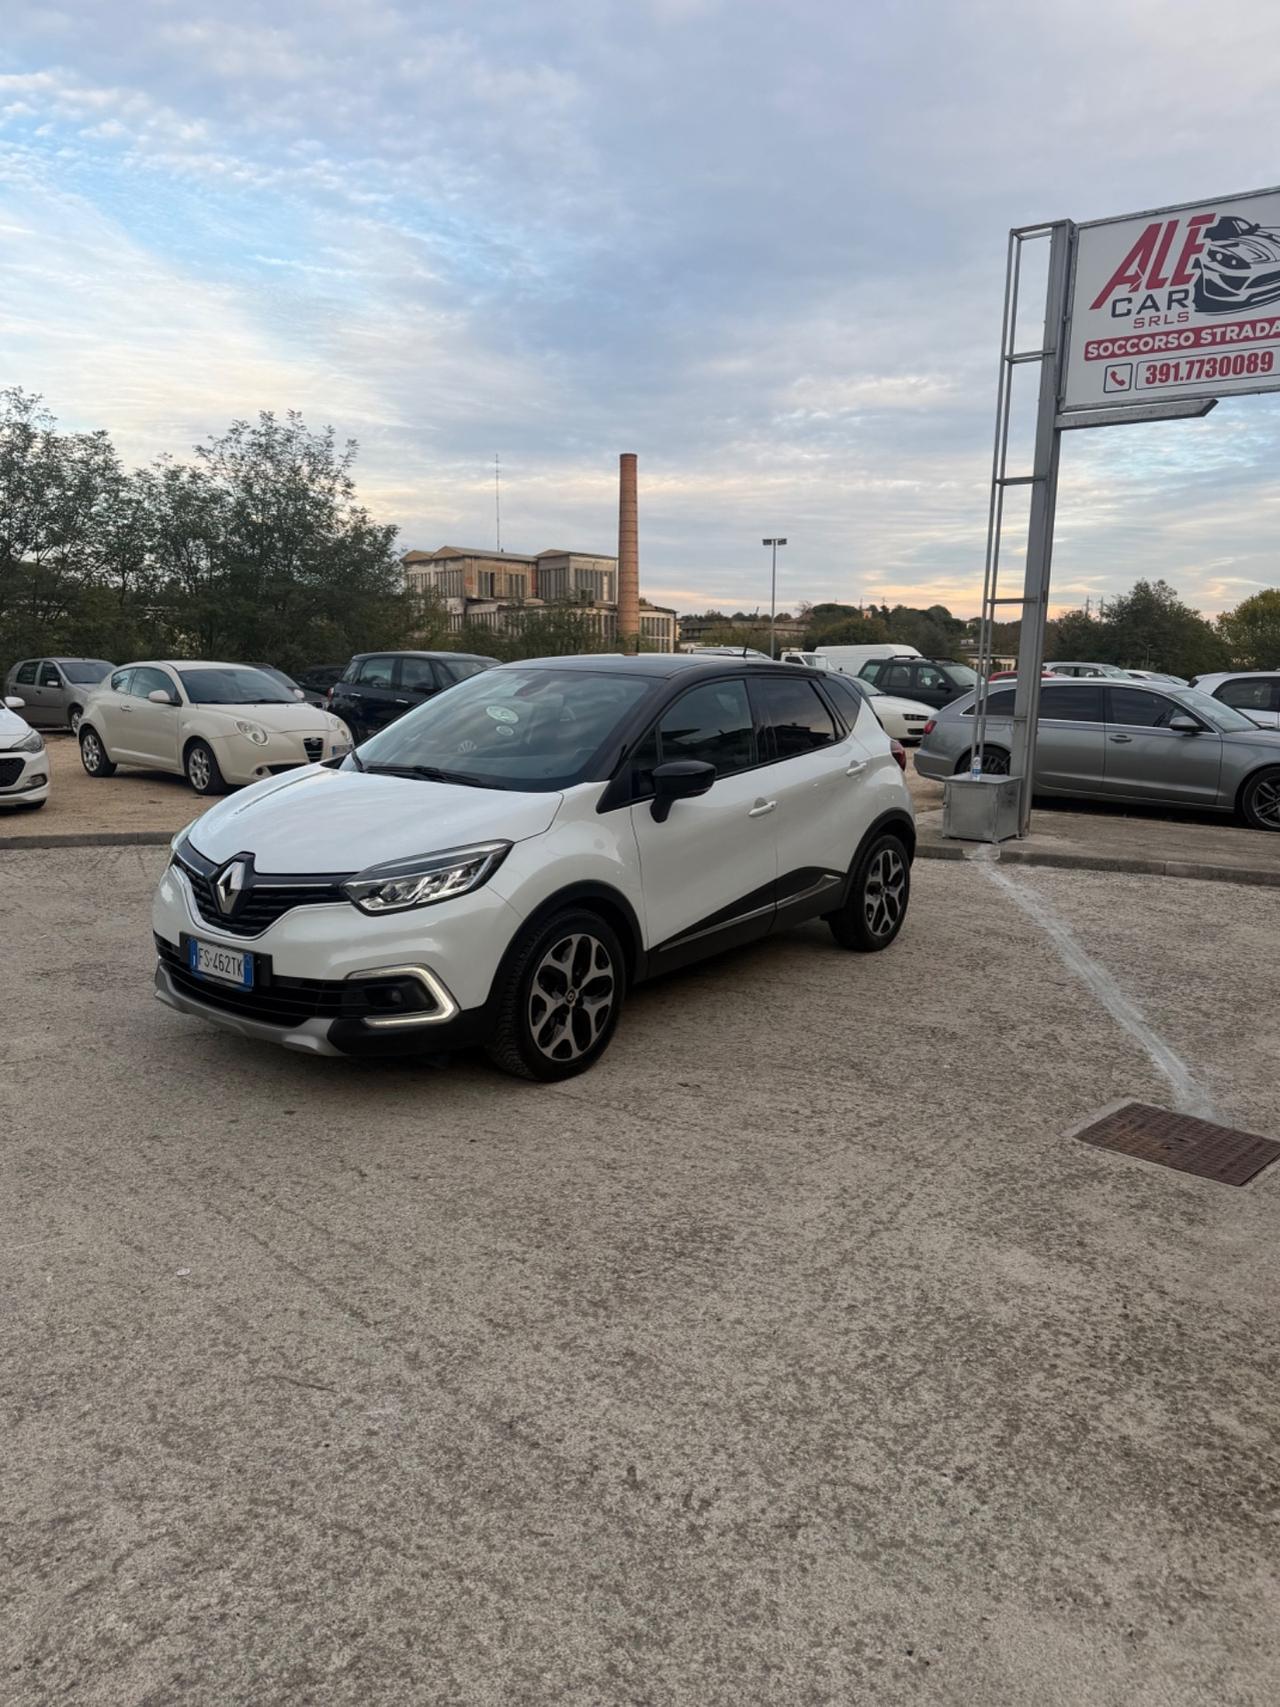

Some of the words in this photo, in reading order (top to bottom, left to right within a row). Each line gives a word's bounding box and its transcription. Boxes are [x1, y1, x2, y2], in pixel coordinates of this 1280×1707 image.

[1089, 213, 1216, 310] ALE
[1111, 289, 1189, 318] CAR
[1133, 311, 1189, 328] SRLS
[1087, 332, 1194, 358] SOCCORSO
[1145, 351, 1273, 384] 391.7730089
